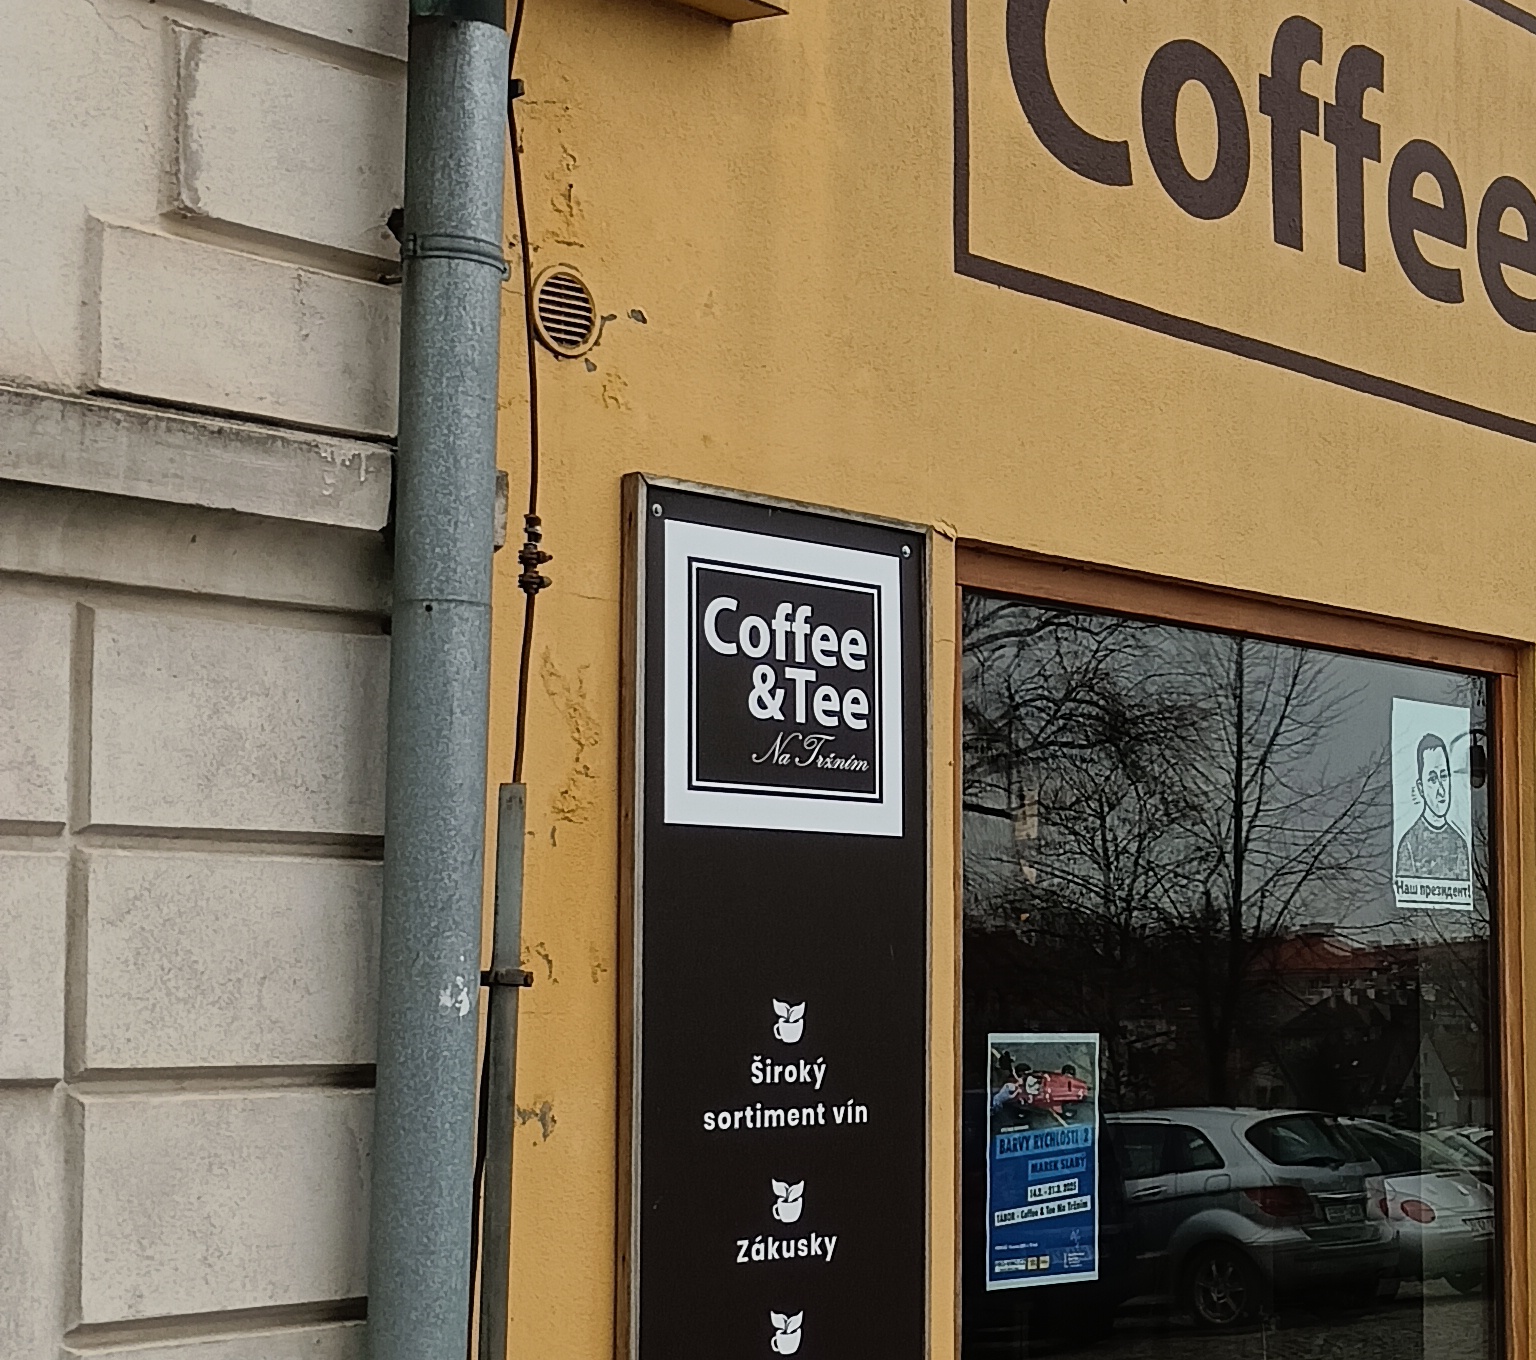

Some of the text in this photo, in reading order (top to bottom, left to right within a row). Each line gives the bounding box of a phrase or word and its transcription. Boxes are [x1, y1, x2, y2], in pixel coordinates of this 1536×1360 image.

[703, 596, 868, 671] Coffee
[748, 664, 869, 730] &Tee
[752, 732, 870, 772] Na Tržním
[1395, 880, 1418, 895] Наш
[750, 1055, 827, 1090] Široký
[703, 1097, 869, 1132] sortiment vín
[999, 1135, 1031, 1155] BARVY
[1033, 1129, 1079, 1150] RYCHLOSTI
[1031, 1160, 1058, 1173] MAREK
[736, 1233, 837, 1263] Zákusky
